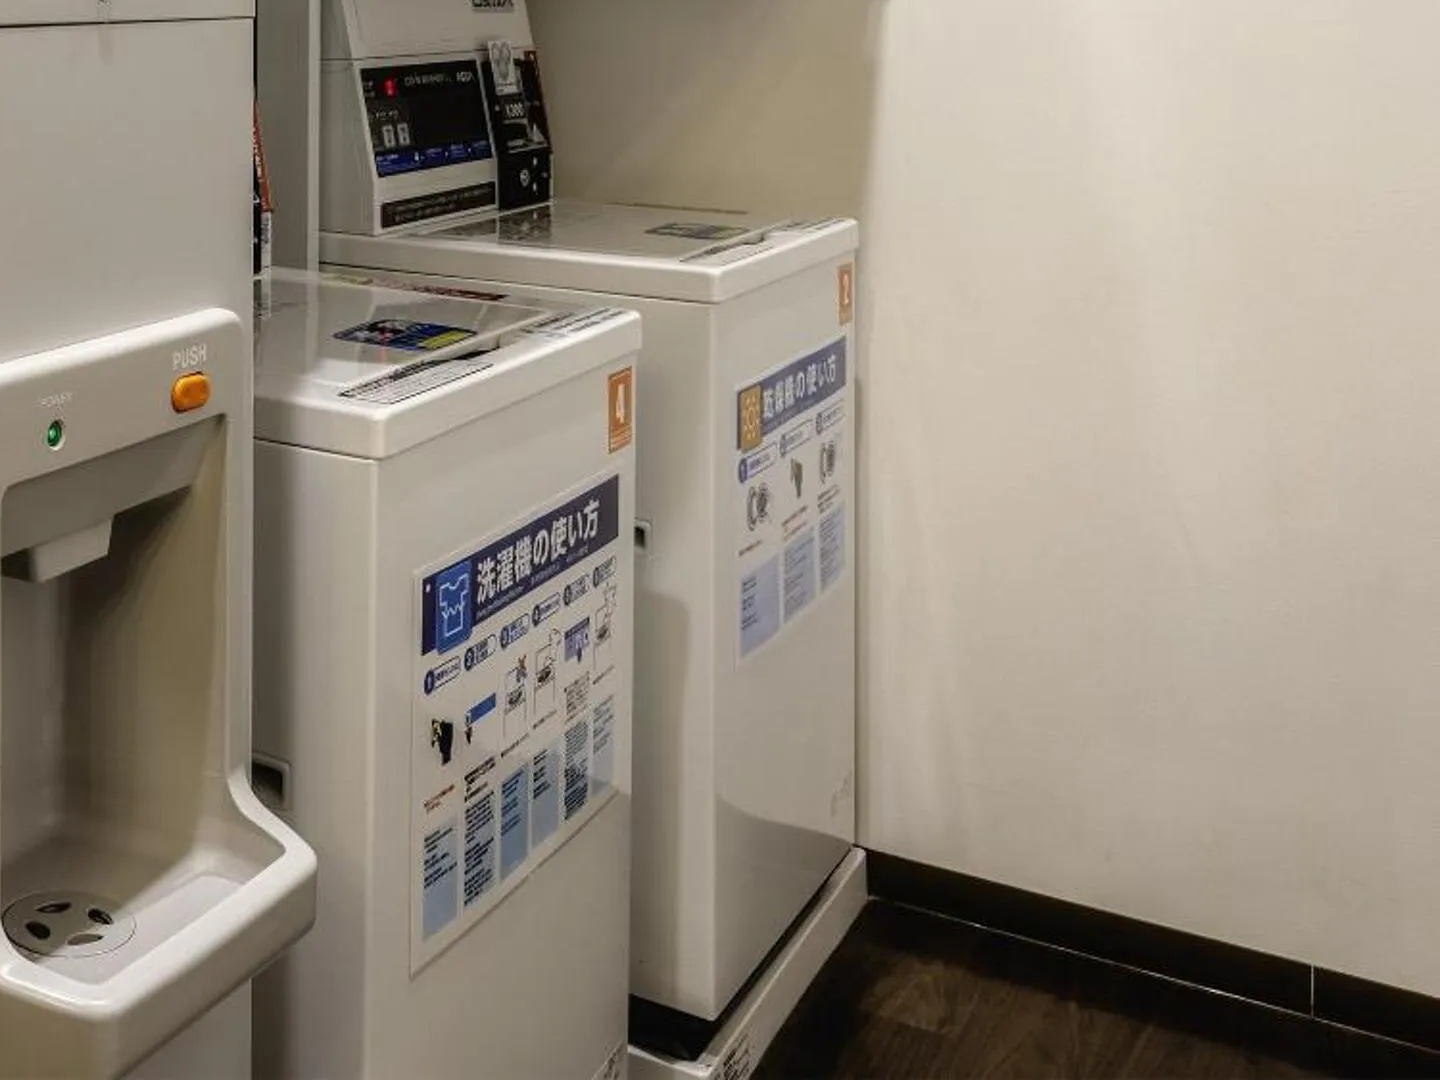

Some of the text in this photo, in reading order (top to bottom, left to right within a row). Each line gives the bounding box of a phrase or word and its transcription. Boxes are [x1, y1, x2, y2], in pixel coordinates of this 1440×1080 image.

[172, 343, 208, 370] PUSH
[615, 383, 626, 423] 4
[476, 498, 600, 604] 洗濯機の使い方
